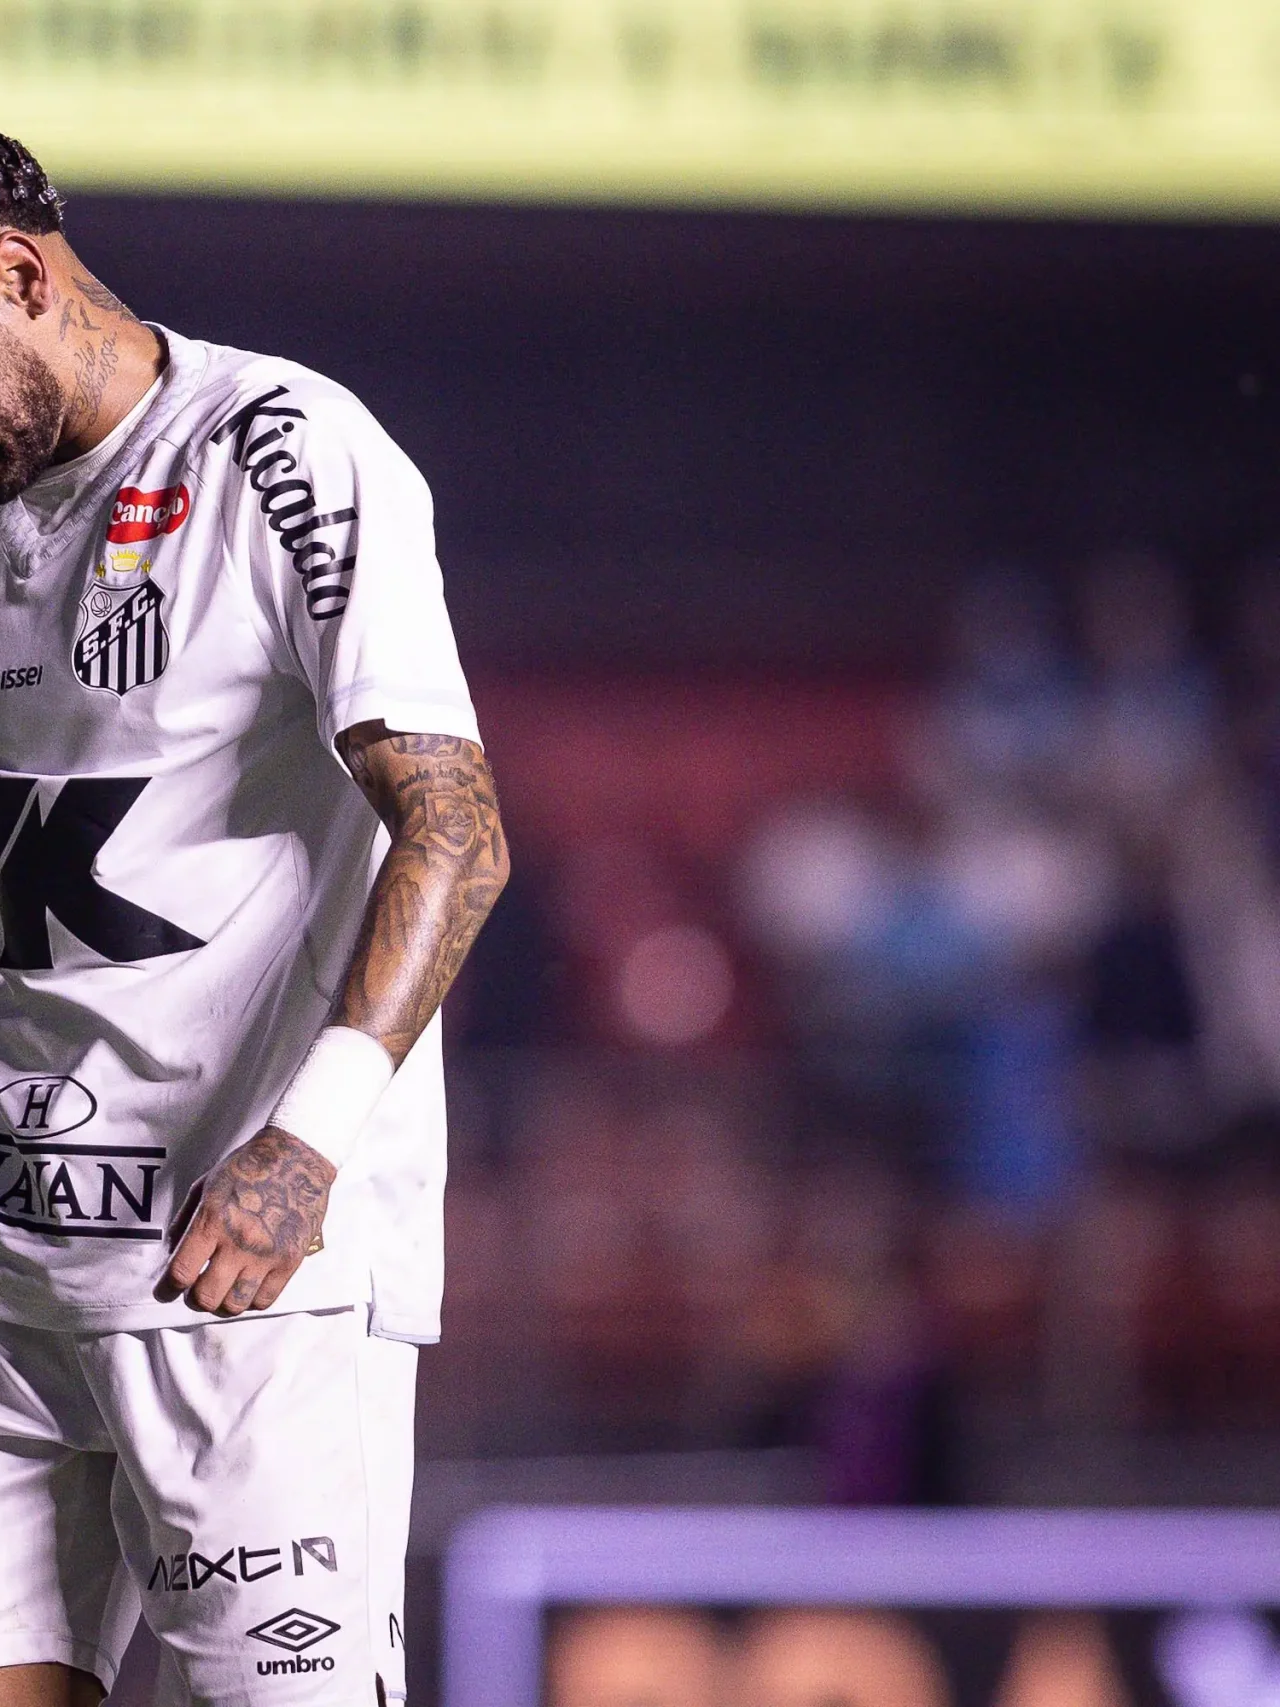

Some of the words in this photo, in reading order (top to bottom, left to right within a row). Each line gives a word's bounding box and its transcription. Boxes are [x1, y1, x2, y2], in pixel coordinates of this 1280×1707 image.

[209, 384, 358, 621] Kicaldo
[16, 1083, 60, 1129] H
[256, 1654, 335, 1676] umbro
